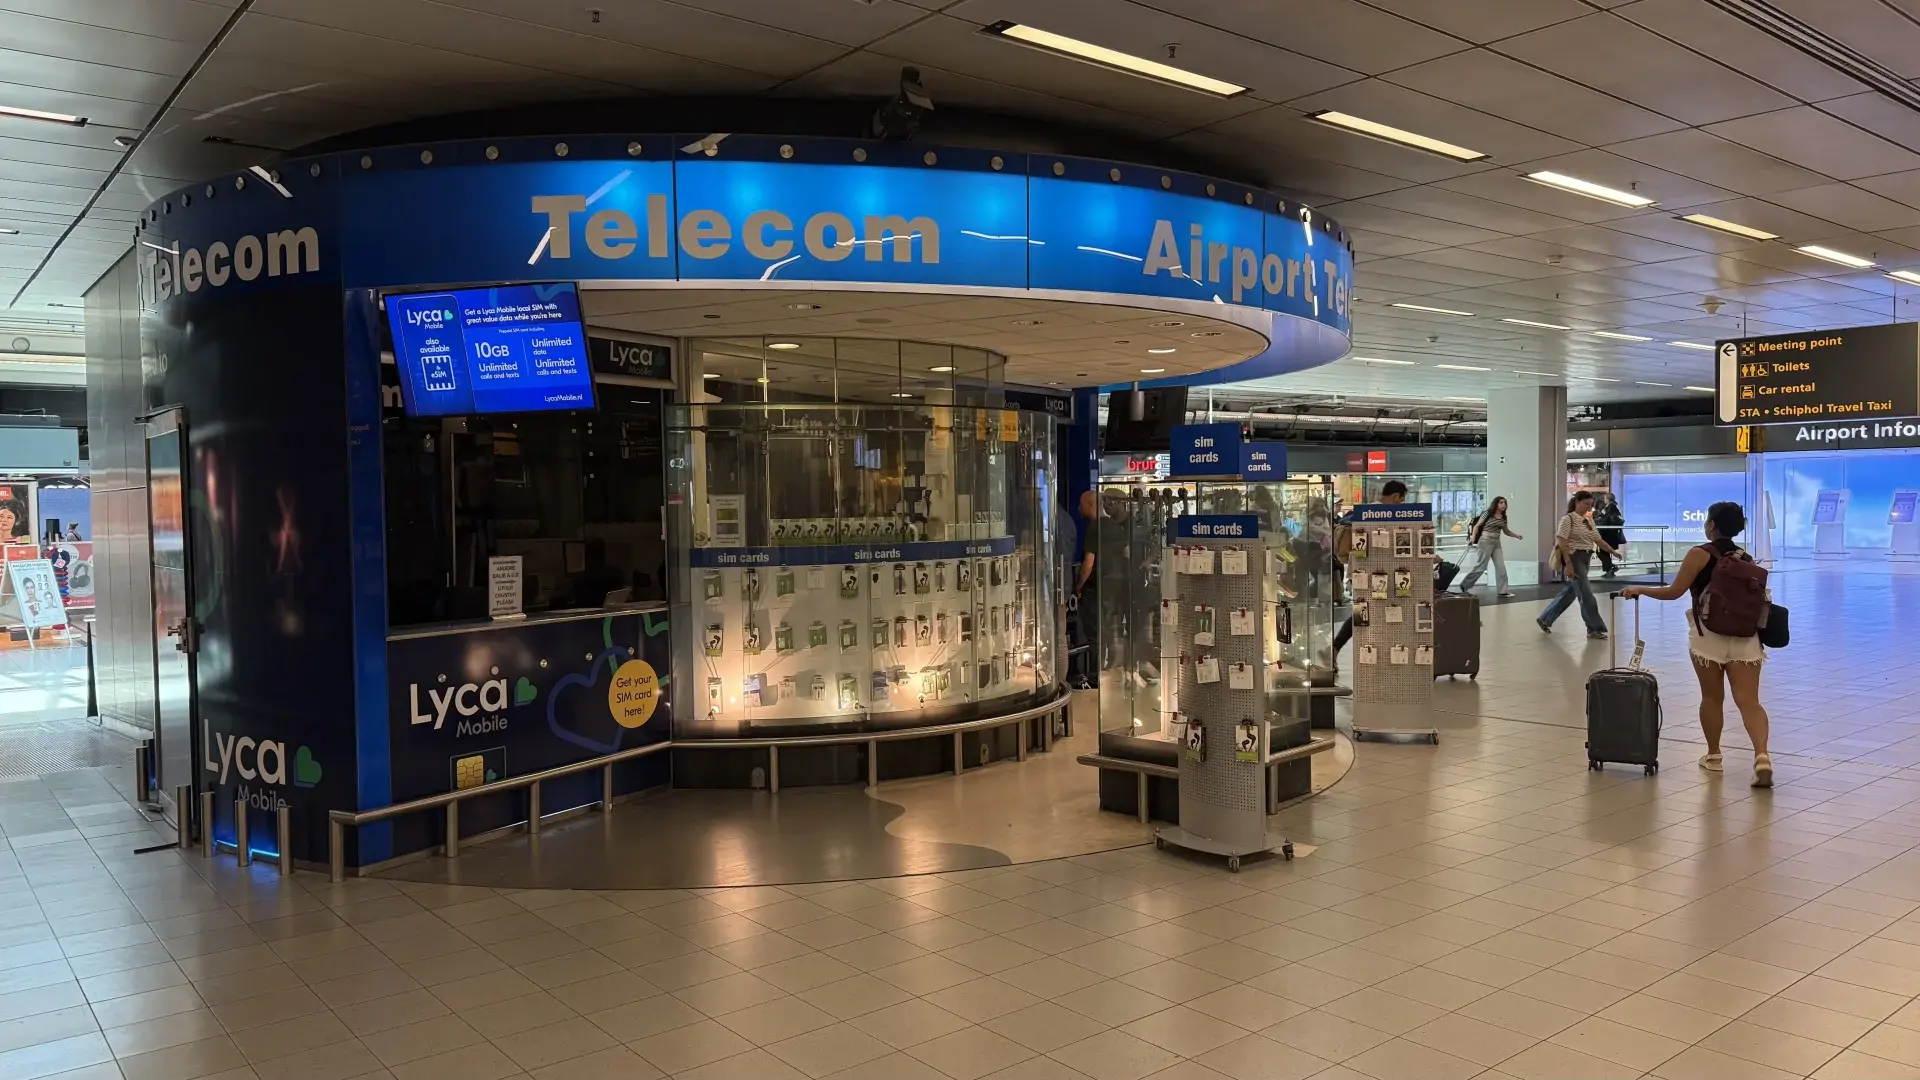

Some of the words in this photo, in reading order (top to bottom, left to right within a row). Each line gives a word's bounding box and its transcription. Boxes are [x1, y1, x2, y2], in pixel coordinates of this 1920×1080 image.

[531, 193, 940, 264] Telecom
[146, 226, 320, 304] Telecom
[1143, 219, 1315, 303] Airport
[464, 308, 476, 316] Get
[496, 306, 516, 314] Mobile
[516, 304, 531, 312] local
[544, 302, 558, 310] with
[406, 309, 442, 326] Lyca
[466, 315, 482, 325] great
[482, 315, 498, 323] value
[498, 314, 513, 322] data
[513, 313, 530, 321] while
[425, 337, 440, 346] also
[531, 336, 572, 348] Unlimited
[1758, 340, 1806, 352] Meeting
[1810, 336, 1843, 352] point
[420, 345, 450, 354] available
[475, 341, 510, 358] 10GB
[610, 341, 653, 367] Lyca
[479, 361, 518, 372] Unlimited
[535, 357, 576, 368] Unlimited
[1773, 361, 1810, 373] Toilets
[505, 371, 520, 379] texts
[563, 367, 578, 375] texts
[628, 364, 653, 376] Mobile
[1758, 385, 1778, 396] Car
[1781, 382, 1816, 395] rental
[544, 393, 583, 403] LycaMobile.nl
[1045, 396, 1064, 411] Lyca
[1739, 407, 1761, 418] STA
[1773, 404, 1823, 417] Schiphol
[1826, 401, 1863, 413] Travel
[1867, 400, 1892, 411] Taxi
[1795, 424, 1868, 443] Airport
[1874, 421, 1920, 438] Info
[1194, 436, 1214, 448] sim
[1189, 451, 1219, 464] cards
[1251, 452, 1267, 460] sim
[1127, 455, 1157, 472] brun
[1247, 462, 1272, 472] cards
[1362, 509, 1393, 520] phone
[1395, 510, 1425, 518] cases
[1682, 509, 1708, 521] Sch
[1192, 522, 1211, 535] sim
[1213, 522, 1243, 535] cards
[717, 552, 737, 563] sim
[740, 552, 770, 563] cards
[854, 549, 872, 560] sim
[874, 548, 901, 559] cards
[616, 676, 632, 688] Get
[634, 675, 652, 688] your
[616, 690, 632, 704] SIM
[634, 687, 652, 700] card
[410, 678, 508, 730] Lyca
[624, 703, 645, 718] here!
[456, 715, 508, 738] Mobile
[204, 718, 286, 786] Lyca
[237, 783, 287, 812] Mobile
